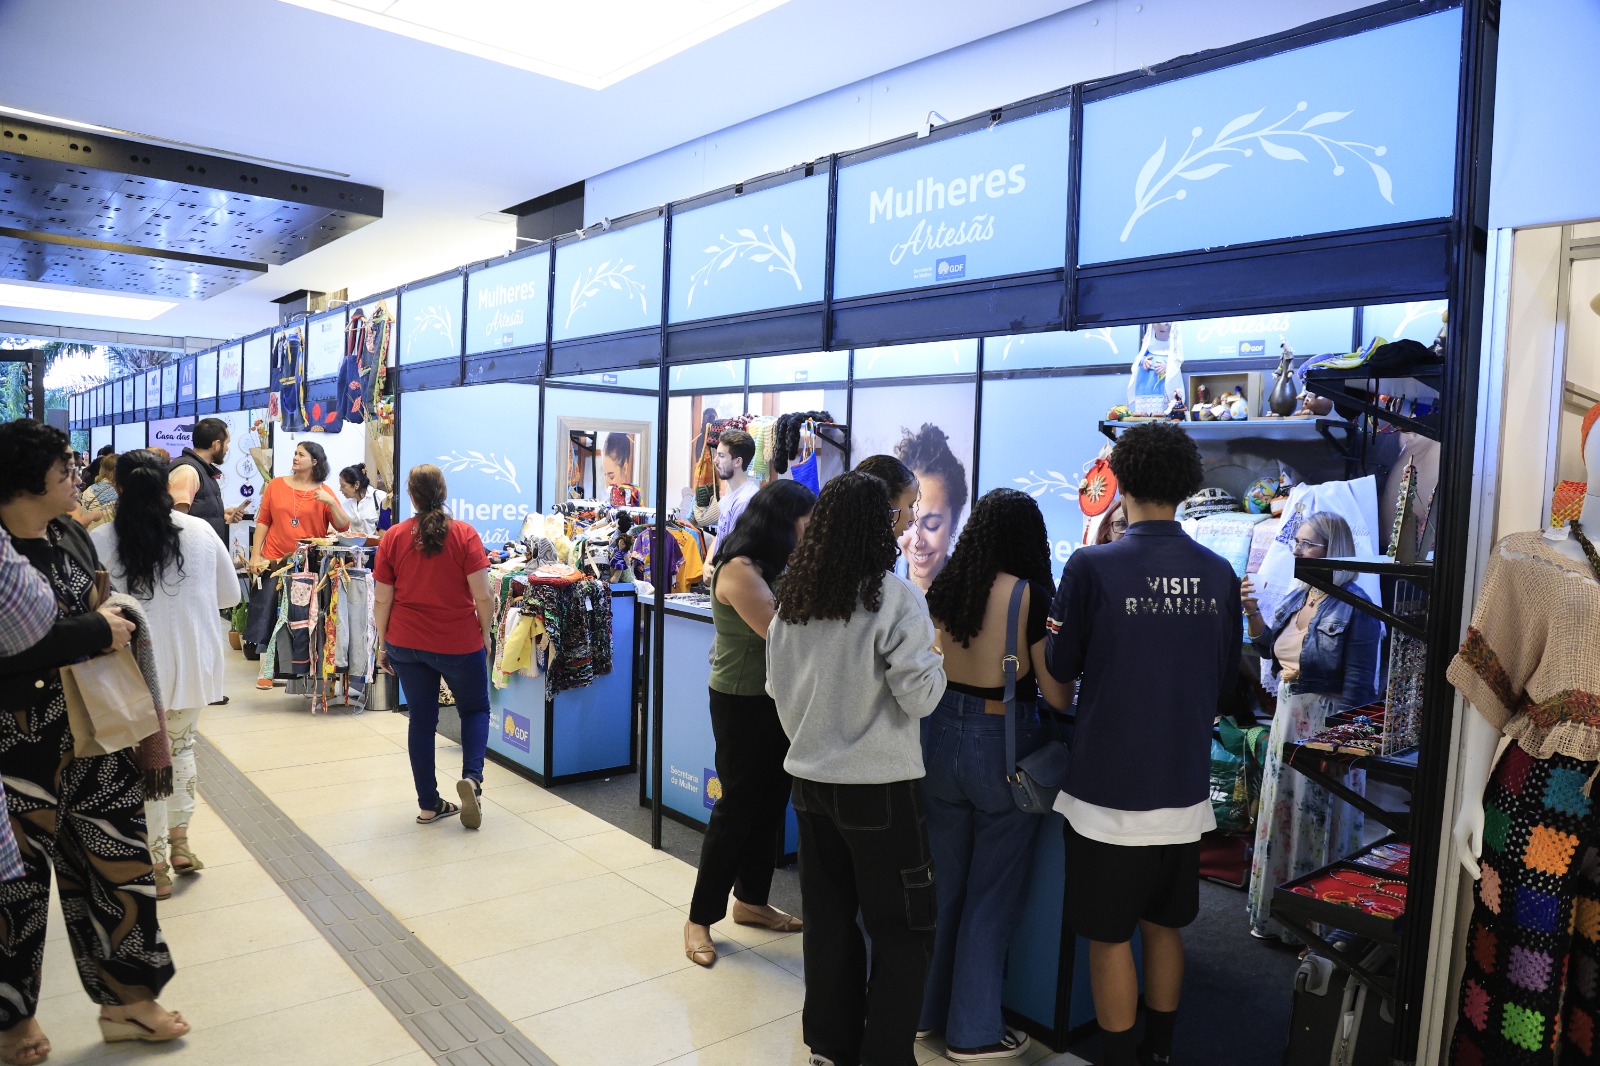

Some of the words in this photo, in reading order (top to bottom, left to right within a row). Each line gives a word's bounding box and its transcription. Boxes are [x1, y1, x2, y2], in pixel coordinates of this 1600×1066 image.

[869, 163, 1026, 224] Mulheres
[889, 213, 995, 266] Artesãs
[949, 263, 964, 273] GDF
[478, 280, 535, 310] Mulheres
[485, 308, 524, 336] Artesãs
[155, 430, 175, 440] Casa
[176, 432, 191, 440] das
[411, 499, 529, 520] lheres
[1146, 577, 1200, 595] VISIT
[514, 727, 529, 741] GDF
[670, 765, 699, 783] Secretaria
[670, 777, 678, 785] da
[679, 779, 699, 793] Mulher
